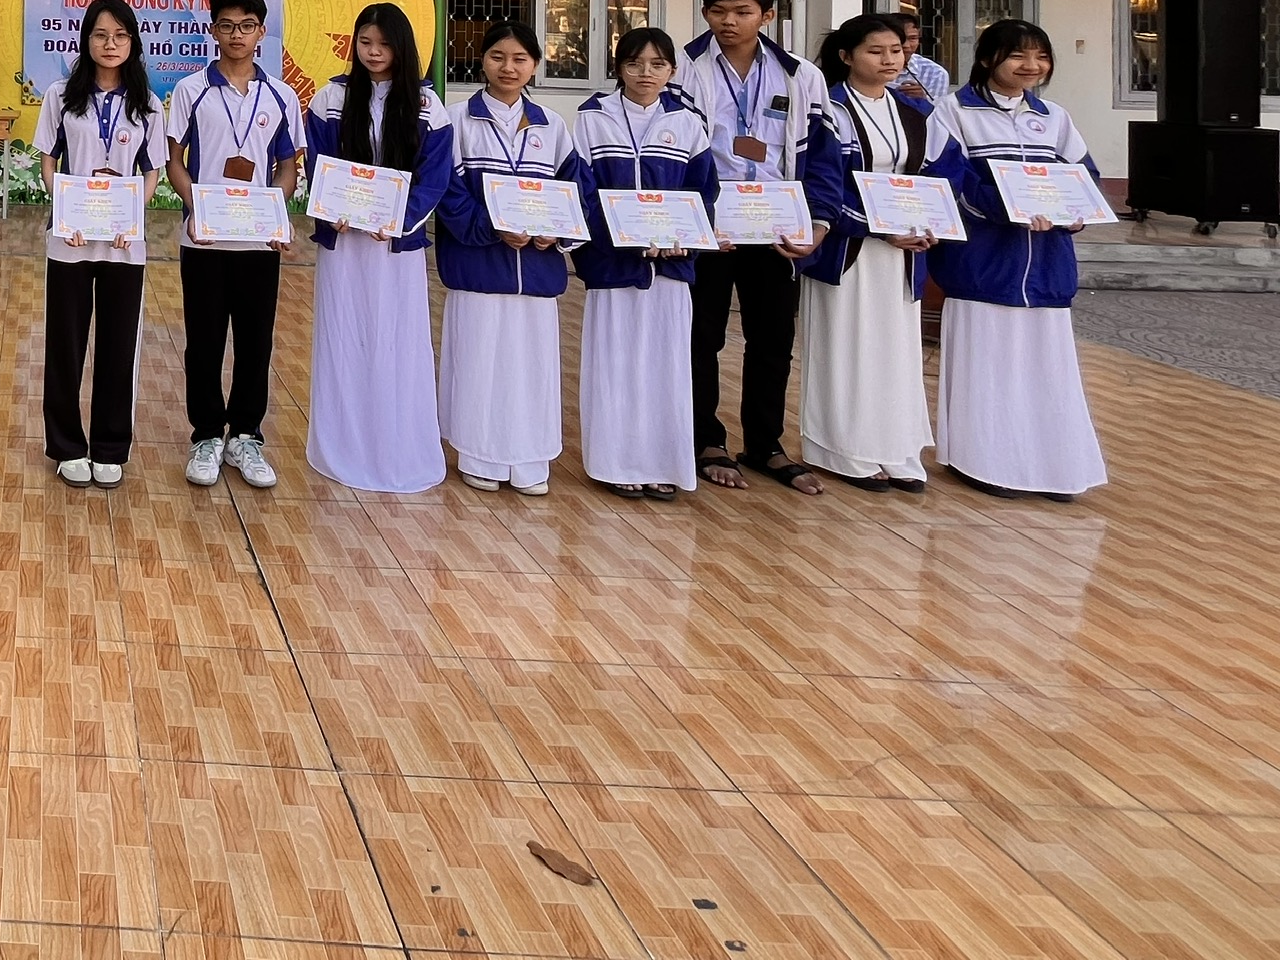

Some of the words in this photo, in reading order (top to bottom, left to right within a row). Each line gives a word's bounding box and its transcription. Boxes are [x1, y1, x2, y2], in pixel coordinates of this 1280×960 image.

[41, 19, 62, 31] 95
[140, 18, 163, 33] ÀY
[168, 19, 213, 34] THÀN
[43, 38, 80, 54] ĐOÀ
[149, 38, 173, 56] HỒ
[178, 41, 208, 57] CHÍ
